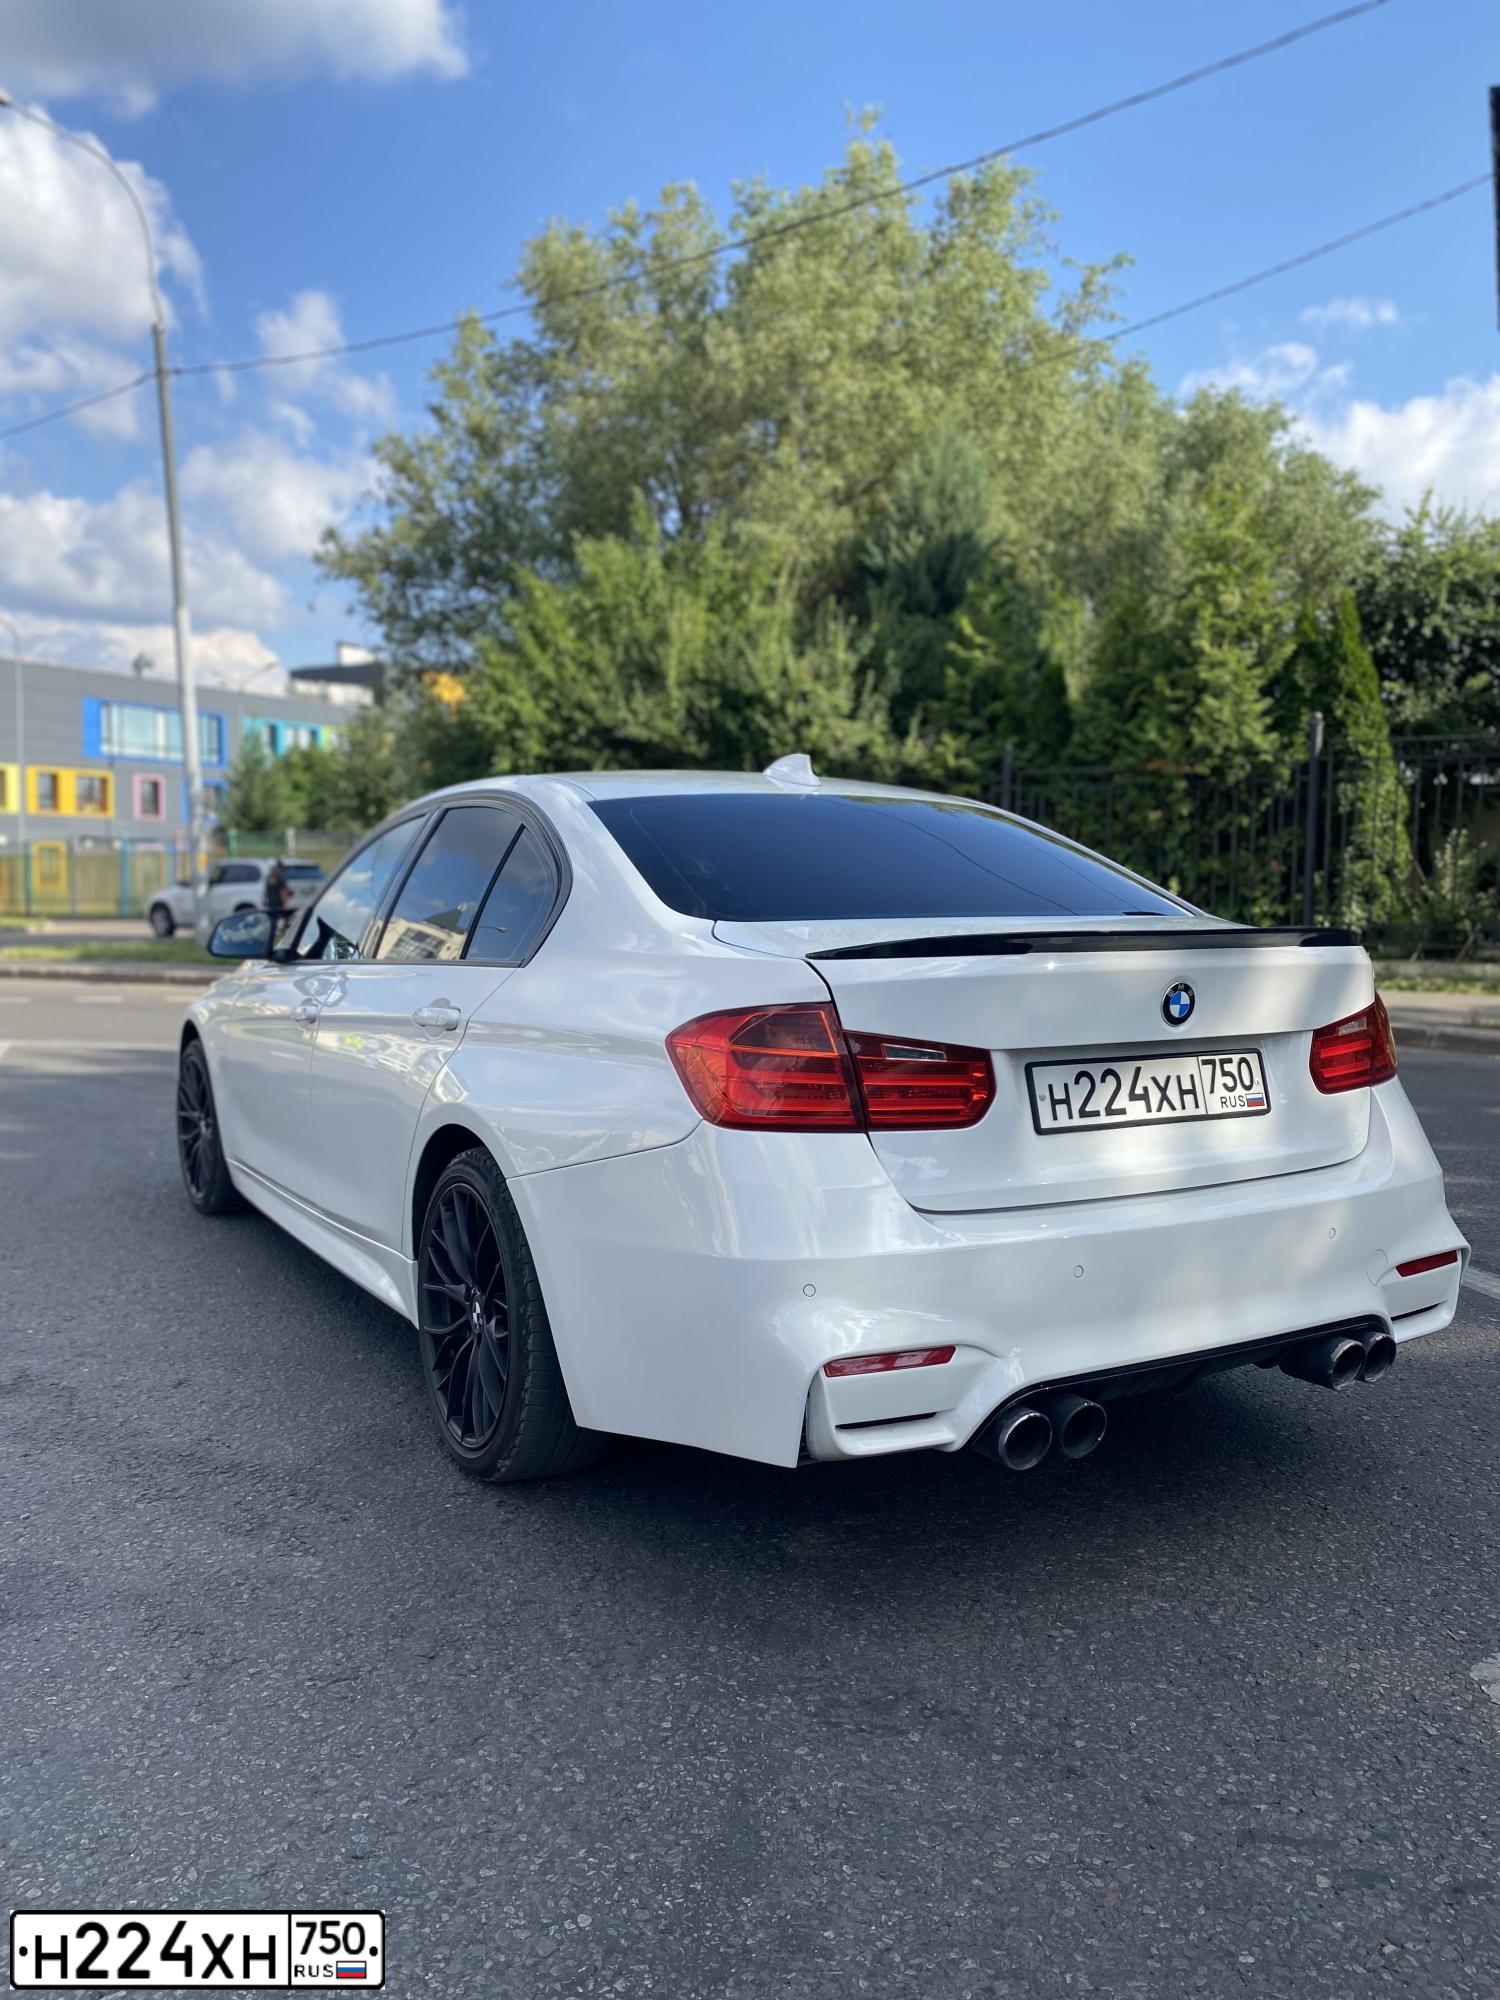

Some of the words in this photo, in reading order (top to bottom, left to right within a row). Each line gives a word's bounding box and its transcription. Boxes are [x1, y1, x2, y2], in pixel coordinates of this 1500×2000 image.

[1167, 983, 1194, 997] BMW
[1201, 1057, 1254, 1095] 750
[1220, 1095, 1246, 1109] RUS
